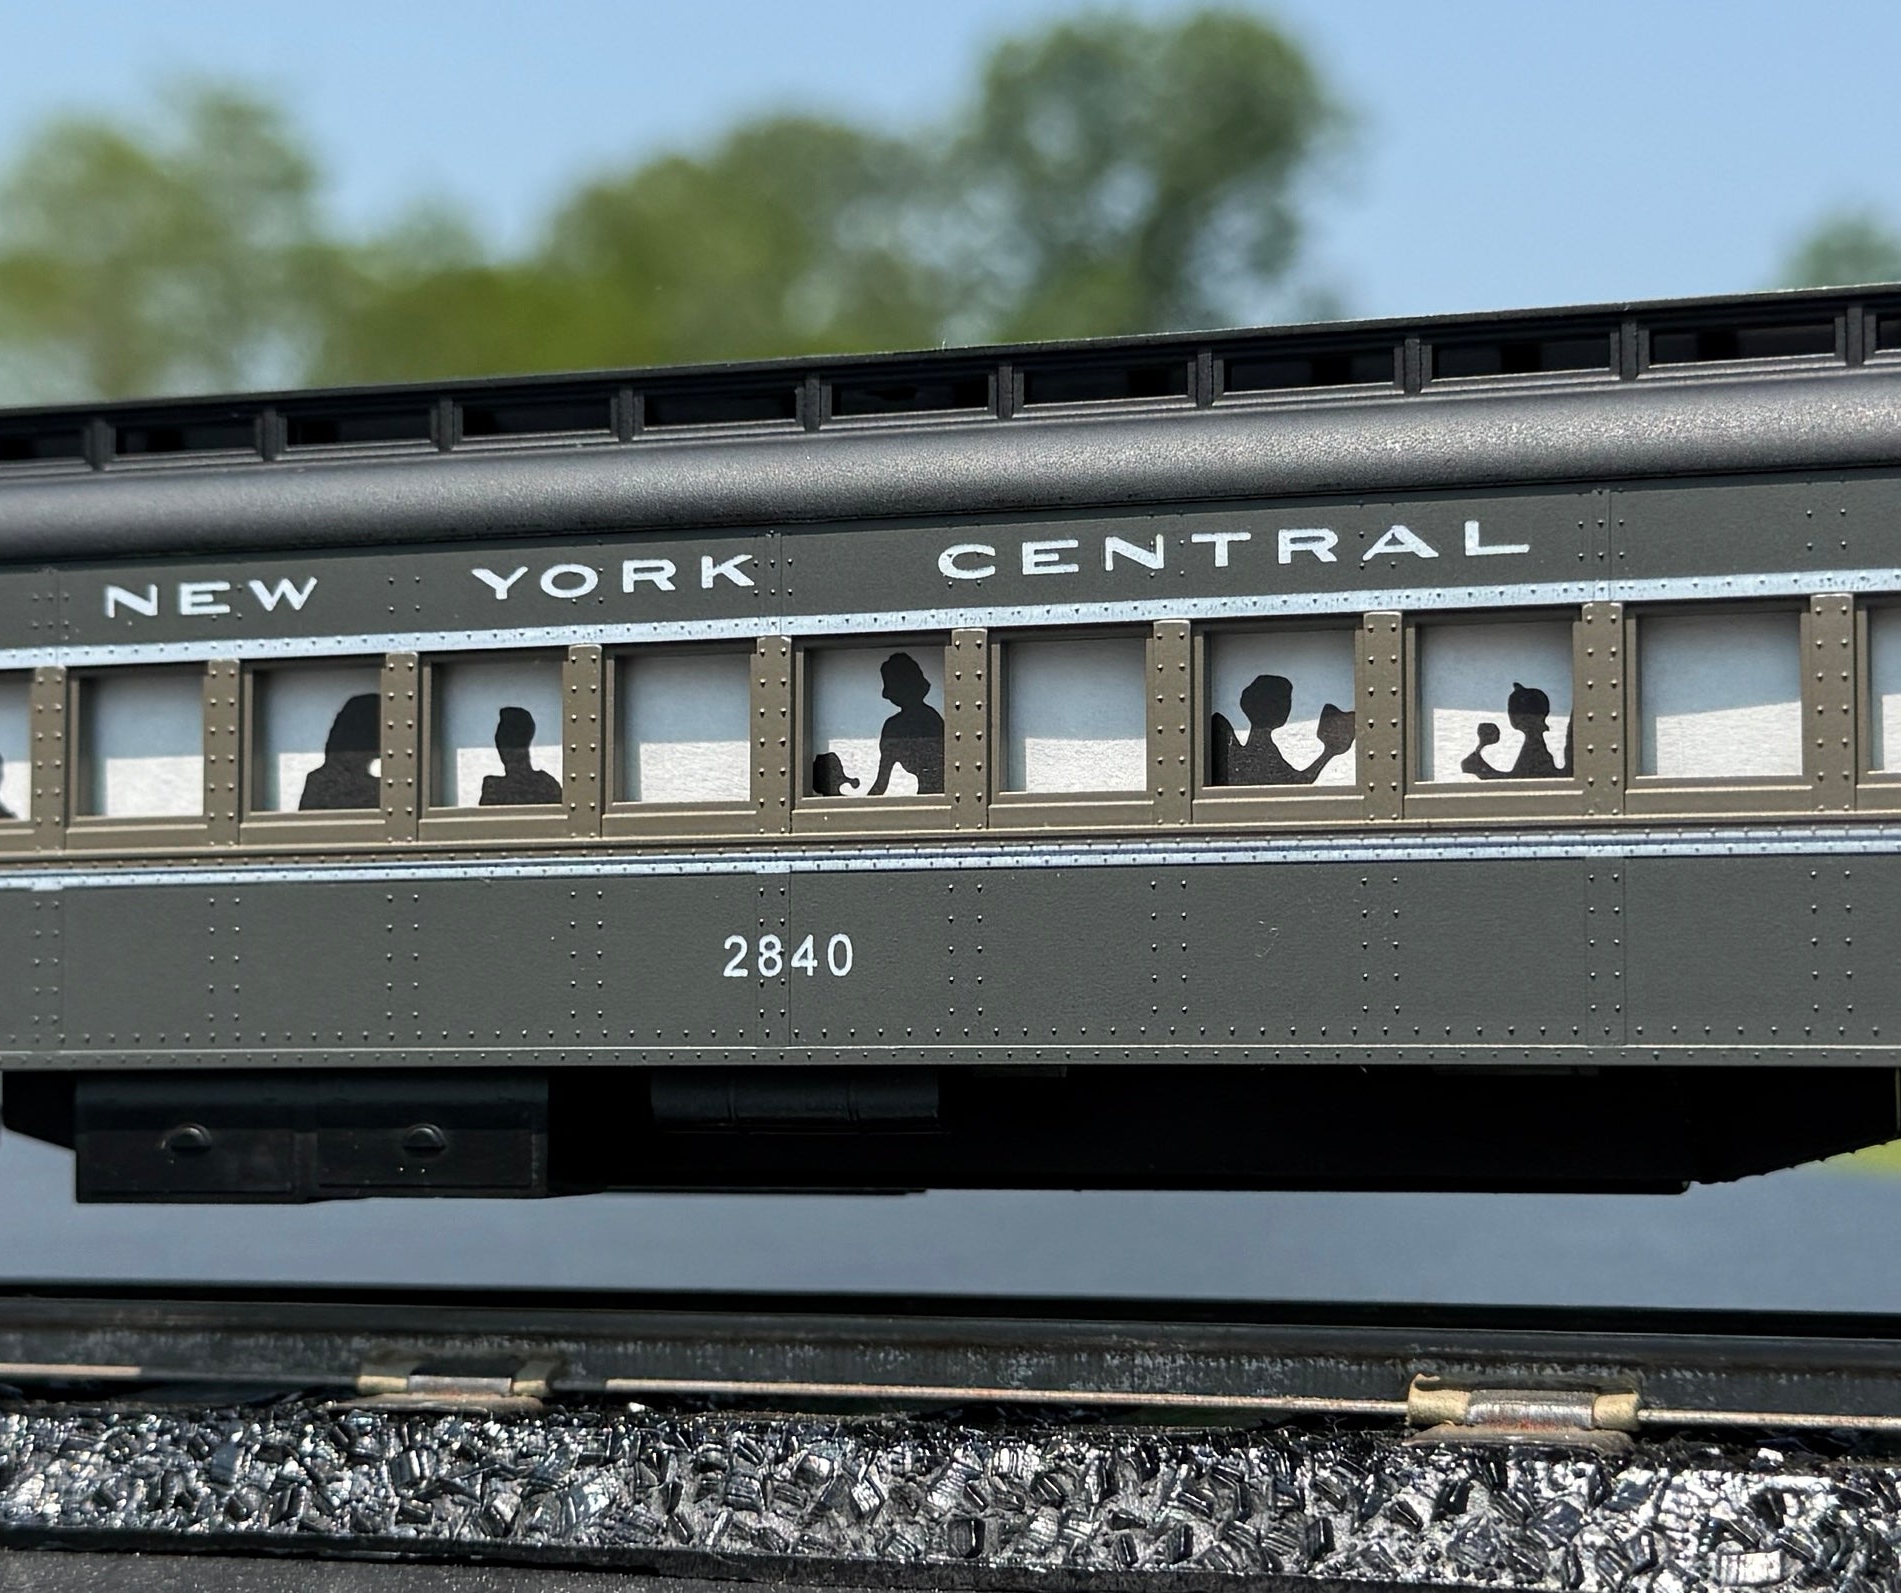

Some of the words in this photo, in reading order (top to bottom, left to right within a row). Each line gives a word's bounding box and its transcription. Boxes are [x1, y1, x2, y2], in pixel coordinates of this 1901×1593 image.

[105, 576, 318, 619] NEW
[471, 554, 755, 600] YORK
[937, 520, 1531, 580] CENTRAL
[722, 933, 854, 978] 2840
